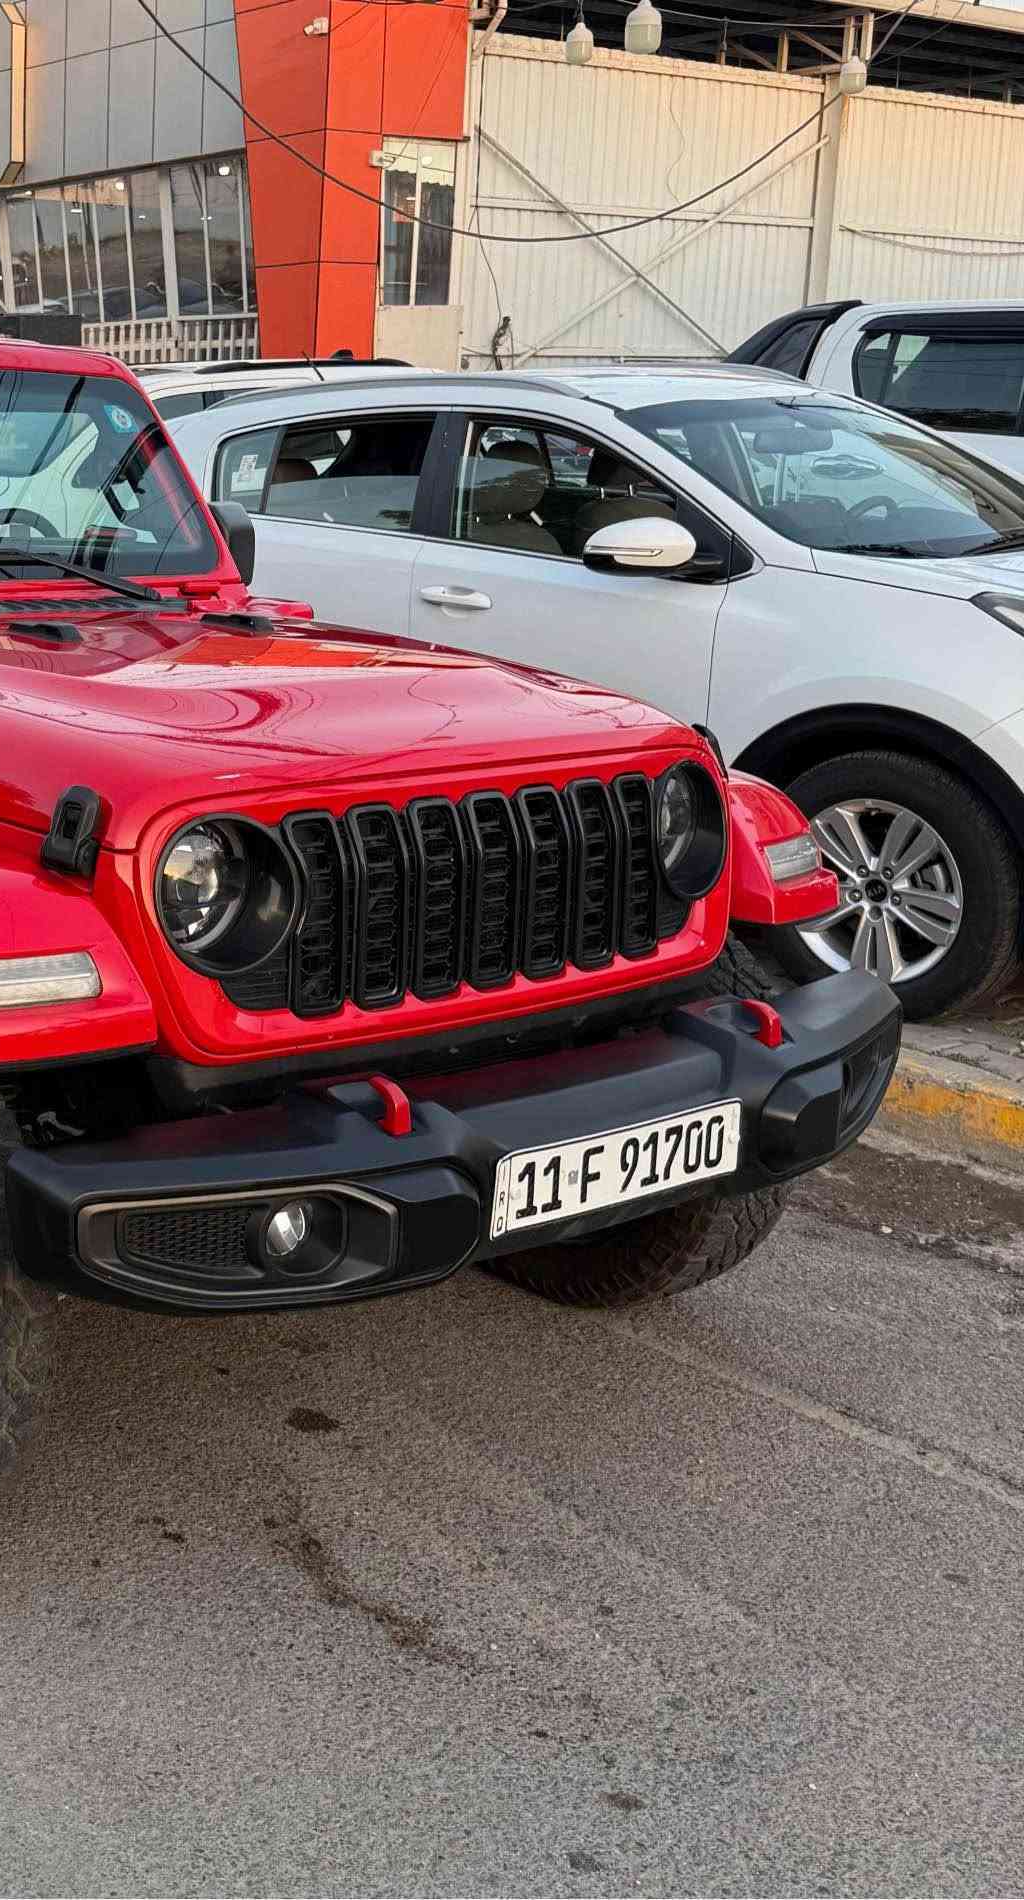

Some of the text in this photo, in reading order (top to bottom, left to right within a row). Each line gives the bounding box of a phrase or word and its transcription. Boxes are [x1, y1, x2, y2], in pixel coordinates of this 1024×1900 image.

[516, 1115, 724, 1219] 11 F 91700
